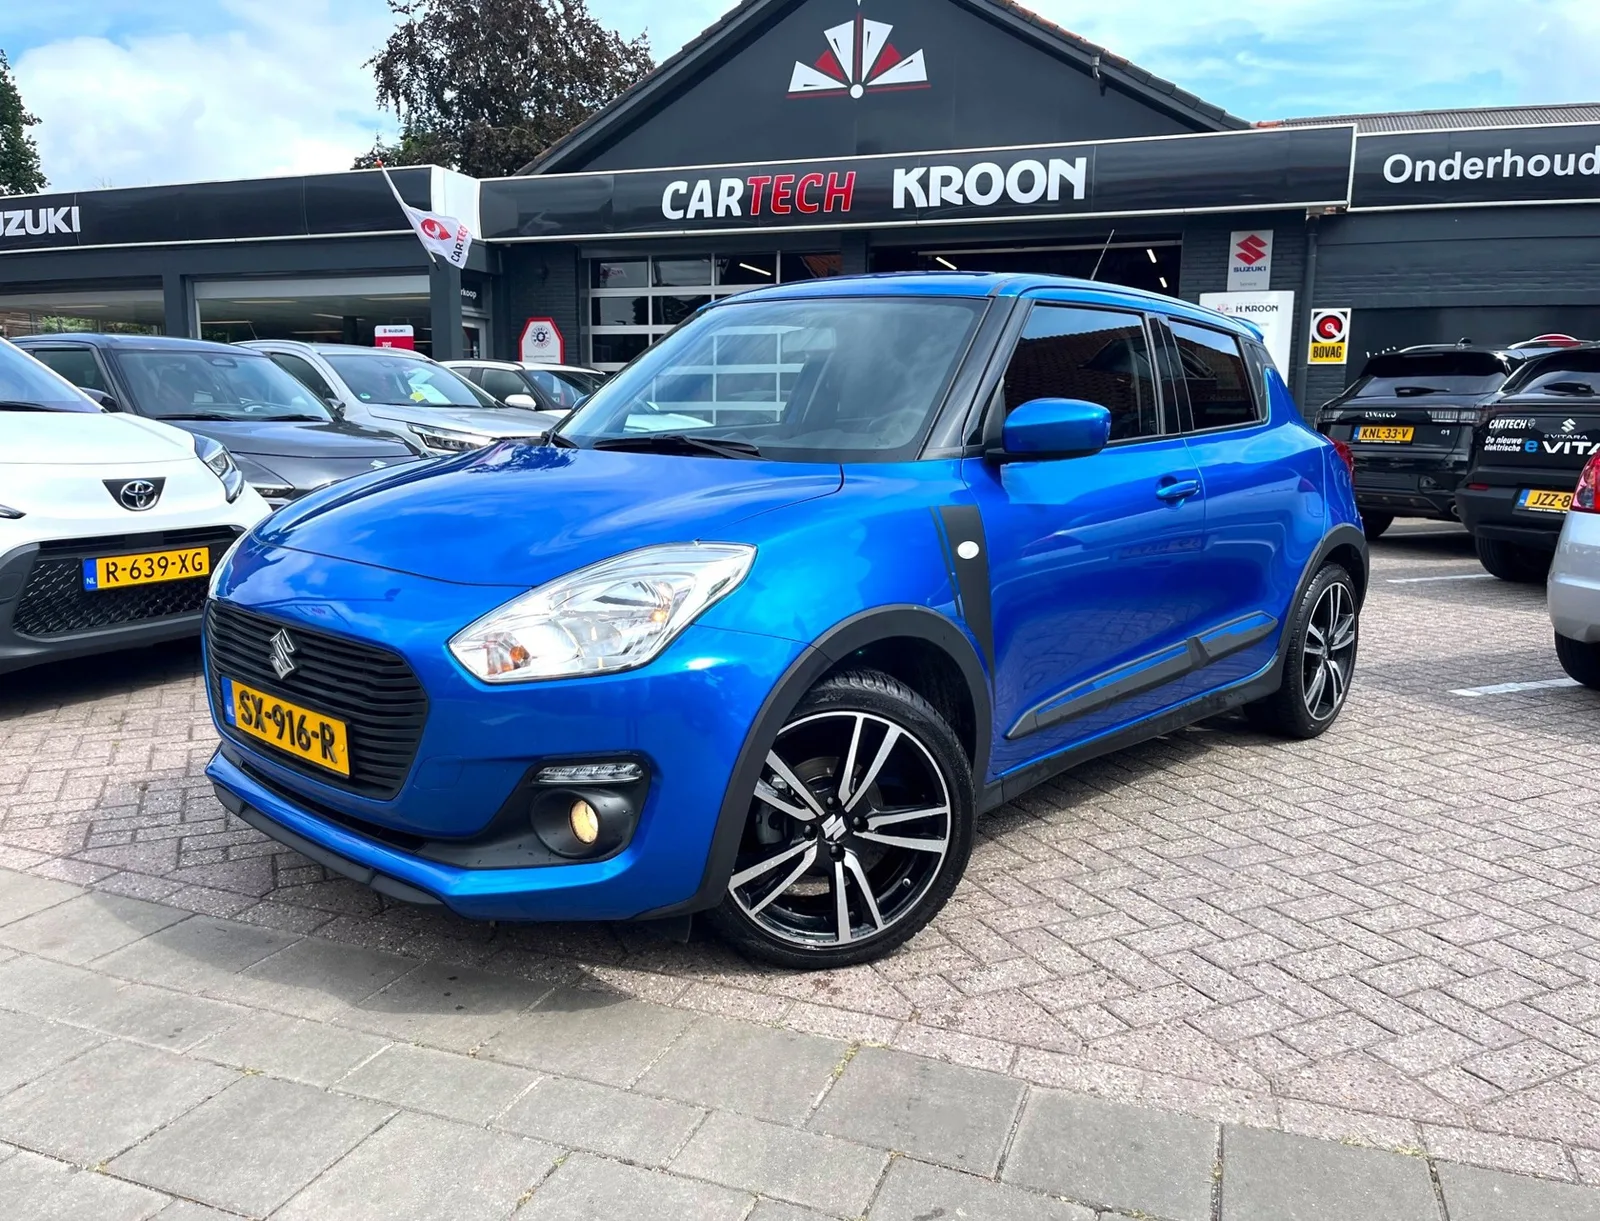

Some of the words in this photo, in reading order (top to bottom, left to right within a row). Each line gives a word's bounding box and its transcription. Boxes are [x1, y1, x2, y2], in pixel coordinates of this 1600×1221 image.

[1383, 145, 1600, 184] Onderhoud
[661, 171, 857, 220] CARTECH
[892, 156, 1088, 209] KROON
[450, 224, 468, 263] CARTEC
[1233, 265, 1267, 273] SUZUKI
[460, 287, 477, 300] rkoop
[1313, 345, 1342, 359] BOVAG
[1488, 418, 1527, 429] CARTECH
[1361, 427, 1409, 439] KNL-33-V
[1485, 435, 1494, 444] De
[1496, 435, 1523, 445] nieuwe
[1483, 444, 1521, 452] elektrische
[1532, 492, 1572, 508] JZZ-8
[86, 577, 96, 585] NL
[105, 552, 203, 583] R-639-XG
[239, 689, 338, 764] SX-916-R
